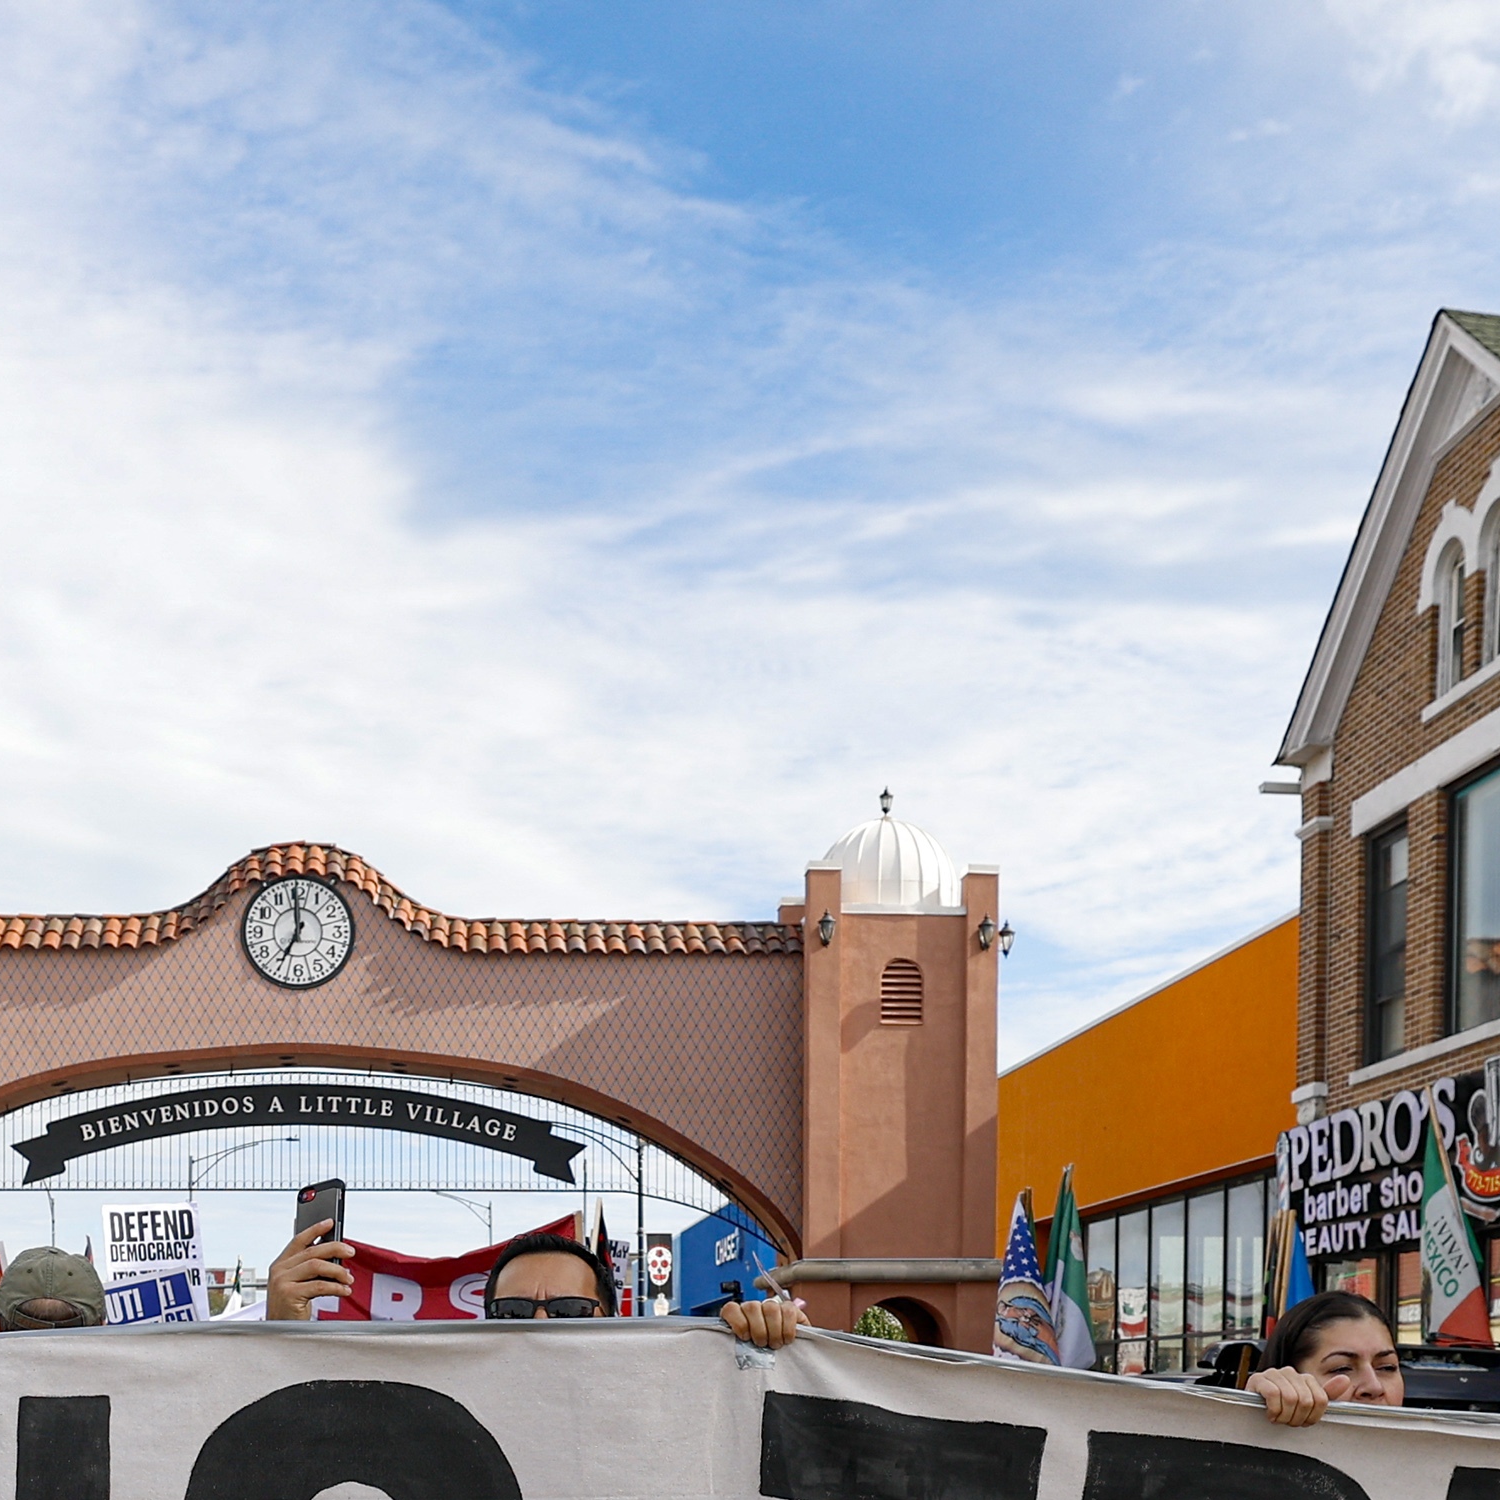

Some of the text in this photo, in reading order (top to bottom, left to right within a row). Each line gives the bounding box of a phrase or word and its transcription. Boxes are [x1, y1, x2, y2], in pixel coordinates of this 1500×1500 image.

[273, 892, 283, 905] 11
[314, 892, 320, 905] 1
[259, 906, 271, 920] 10
[326, 905, 337, 919] 2
[253, 925, 263, 939] 9
[332, 925, 342, 939] 3
[259, 945, 270, 959] 8
[325, 945, 336, 959] 4
[293, 964, 303, 977] 6
[313, 958, 323, 972] 5
[79, 1096, 517, 1142] BIENVENIDOS A LITTLE VILLAGE
[1288, 1077, 1456, 1193] PEDRO'S
[1303, 1167, 1425, 1224] barber sho
[109, 1209, 194, 1242] DEFEND
[1381, 1206, 1422, 1246] SAL
[110, 1241, 197, 1262] DEMOCRACY:
[105, 1287, 144, 1325] UT!
